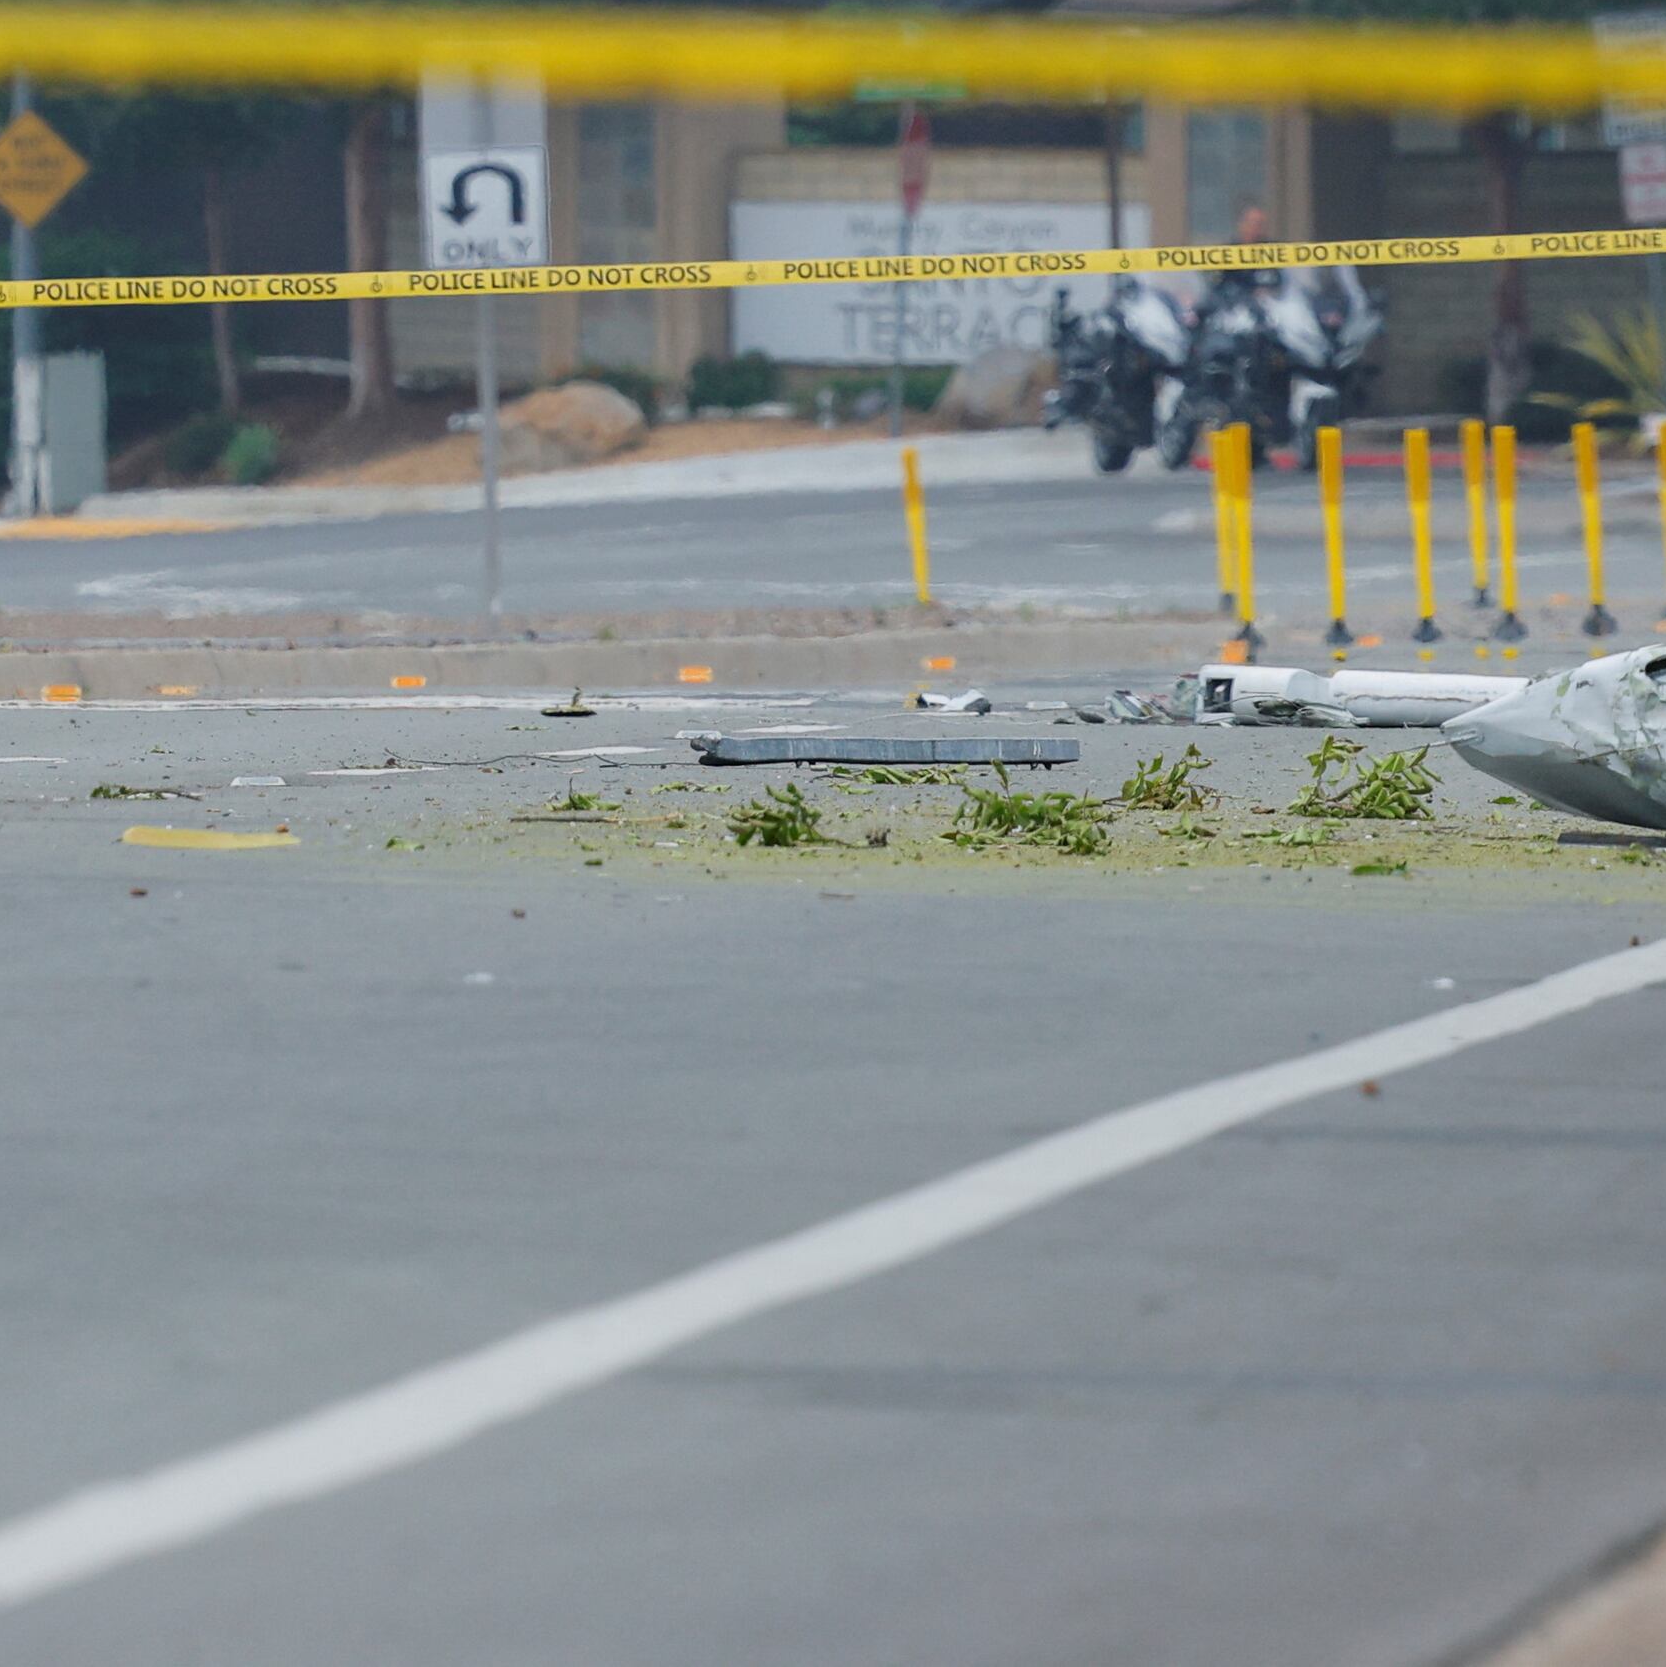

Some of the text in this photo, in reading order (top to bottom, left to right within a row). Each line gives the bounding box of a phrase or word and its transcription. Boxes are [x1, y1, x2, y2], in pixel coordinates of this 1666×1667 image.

[442, 237, 533, 261] ONLY
[1156, 240, 1460, 266] POLICE LINE DO NOT CROSS
[1531, 234, 1607, 253] POLICE
[1612, 231, 1662, 250] LINE
[407, 265, 712, 291] POLICE LINE DO NOT CROSS
[783, 254, 1086, 280] POLICE LINE DO NOT CROSS
[32, 277, 338, 301] POLICE LINE DO NOT CROSS
